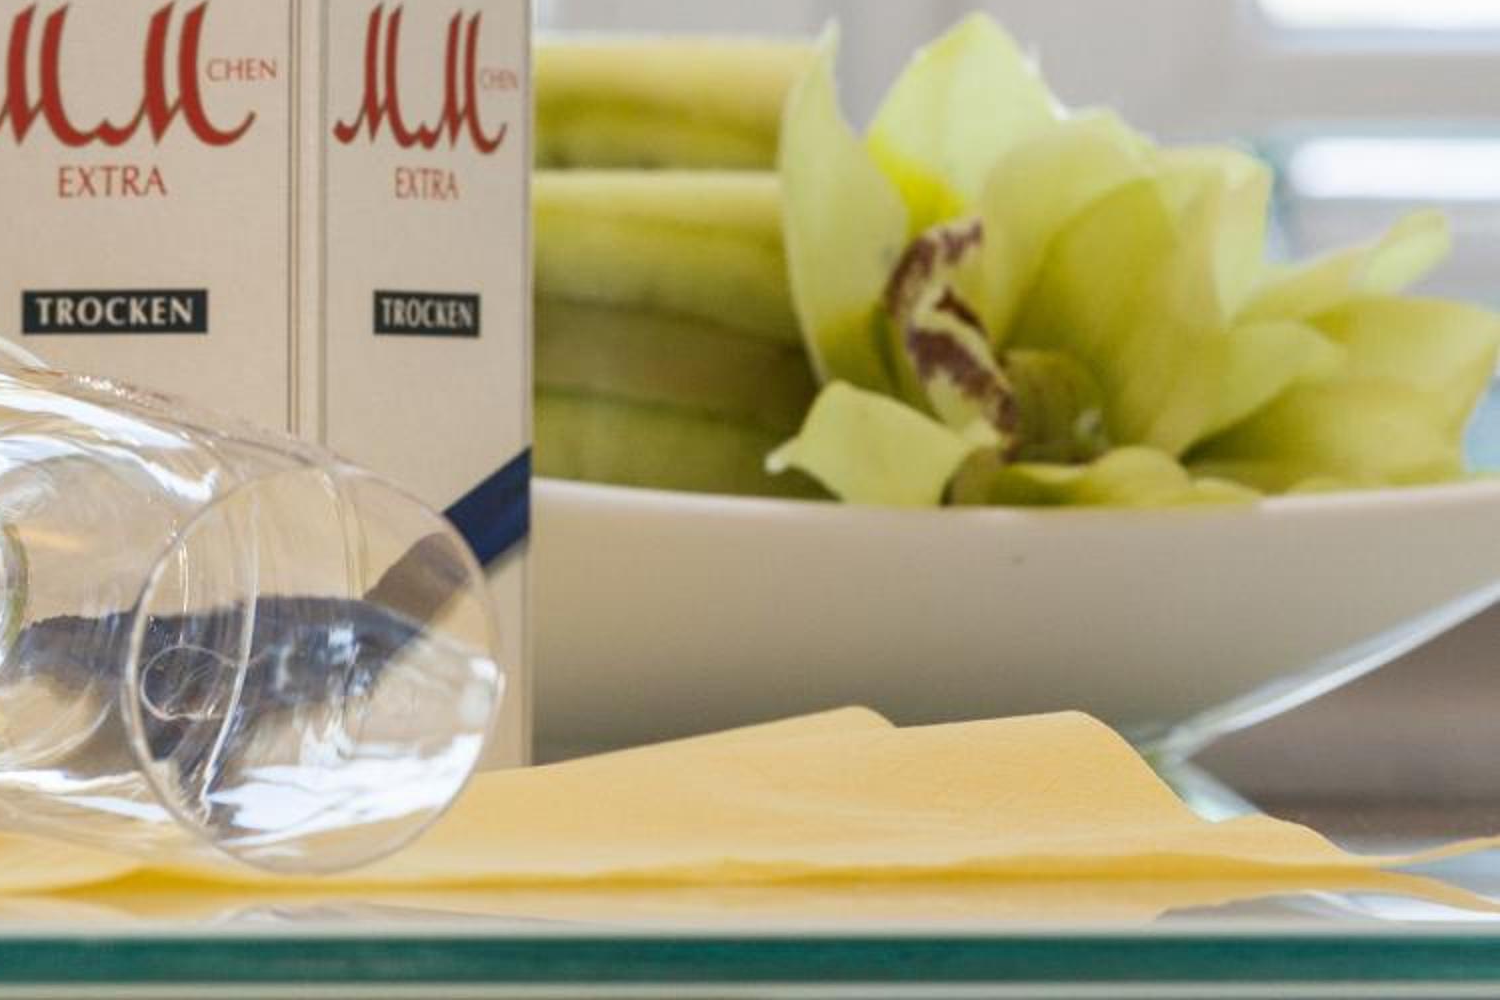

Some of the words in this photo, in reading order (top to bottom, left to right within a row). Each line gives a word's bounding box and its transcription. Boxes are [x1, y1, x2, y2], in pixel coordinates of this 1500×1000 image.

[206, 57, 277, 83] CHEN
[479, 67, 519, 91] CHEN
[57, 165, 168, 198] EXTRA
[394, 166, 460, 200] EXTRA
[35, 295, 194, 327] TROCKEN
[380, 297, 474, 329] TROCKEN
